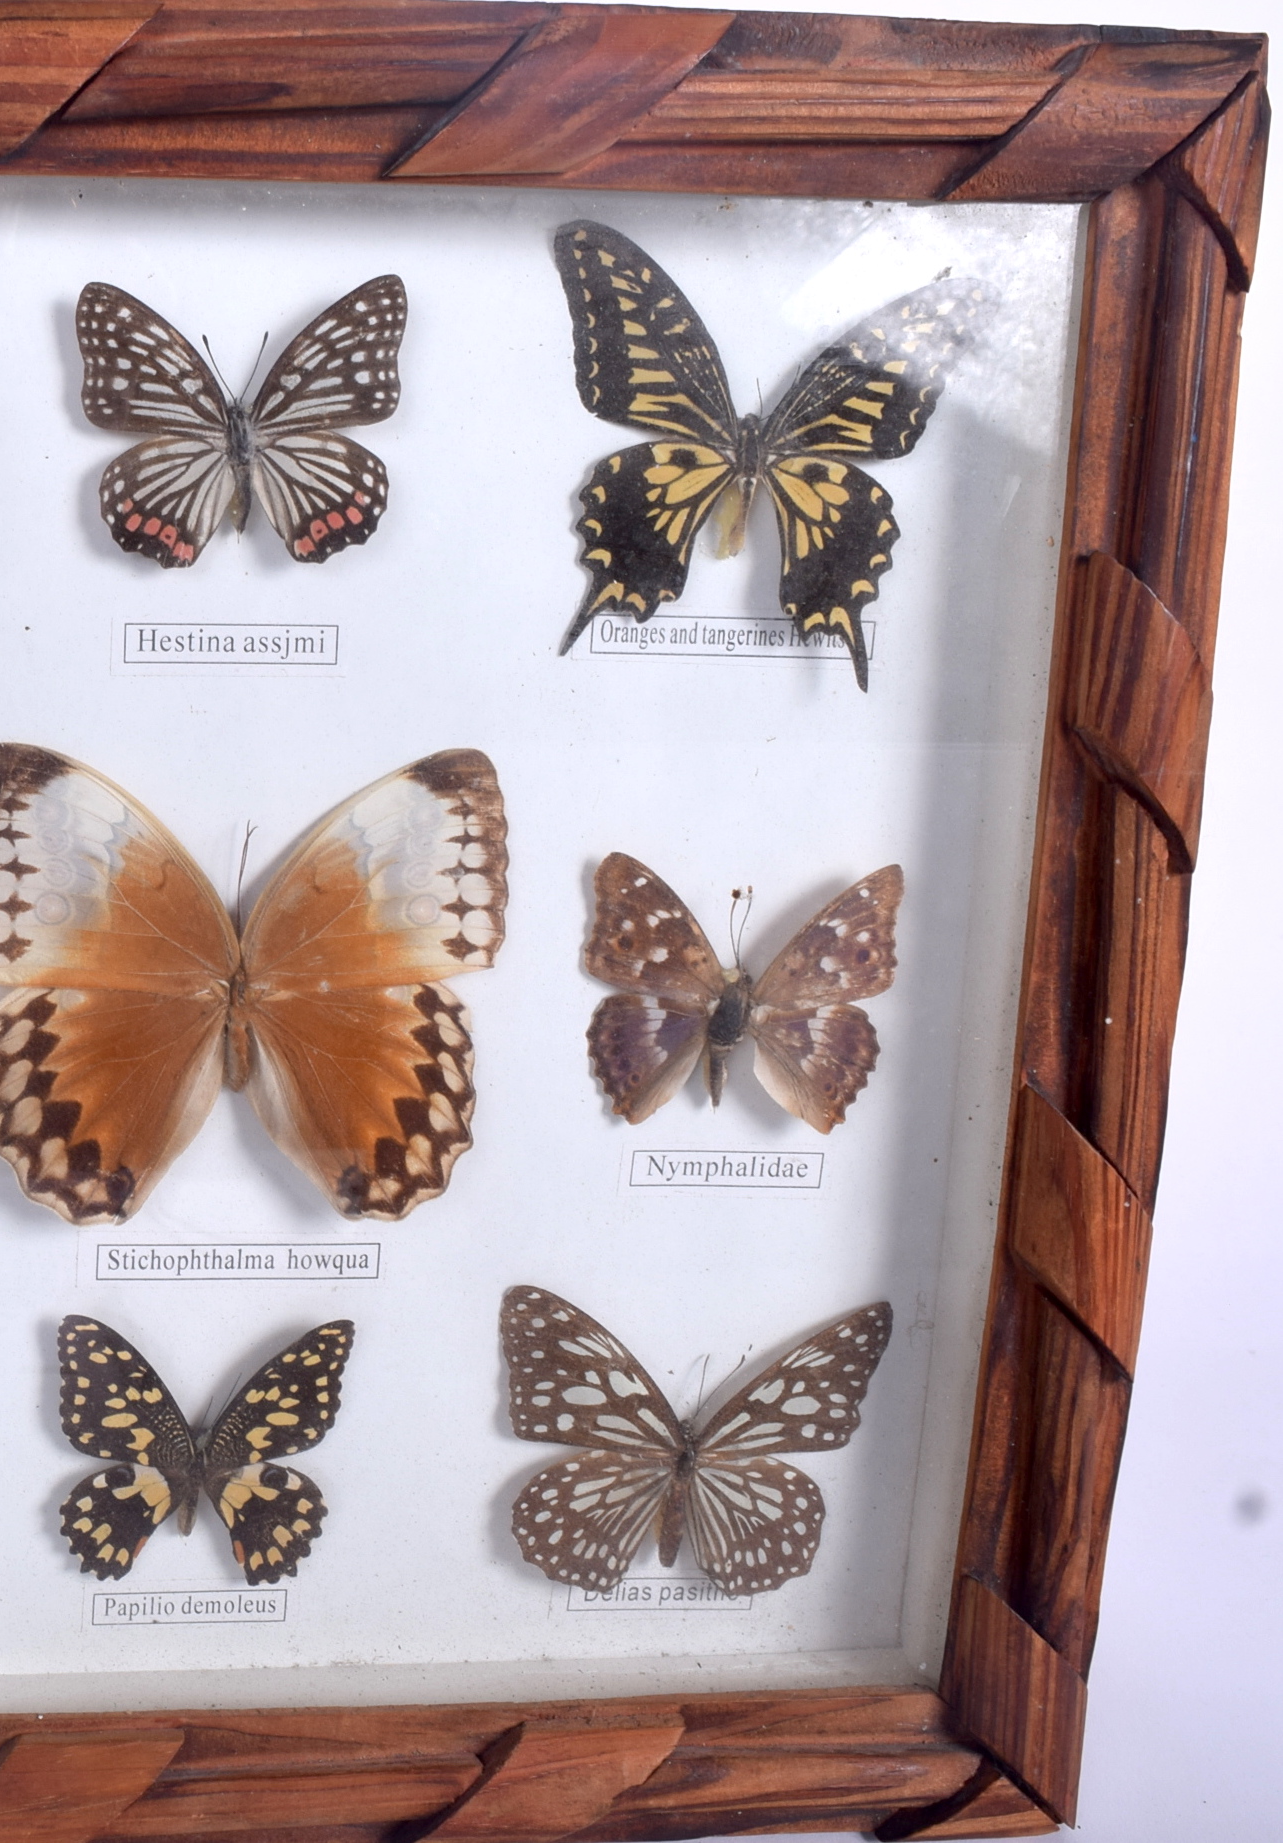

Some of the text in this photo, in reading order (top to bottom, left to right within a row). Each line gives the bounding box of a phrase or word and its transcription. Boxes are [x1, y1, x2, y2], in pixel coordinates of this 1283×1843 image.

[138, 629, 235, 653] Hestina
[600, 619, 665, 650] Oranges
[670, 622, 698, 646] and
[702, 623, 785, 651] tangerines
[647, 1155, 808, 1182] Nymphalidae
[107, 1248, 369, 1275] Stichophthalma howqua
[104, 1594, 276, 1620] Papilio demoleus
